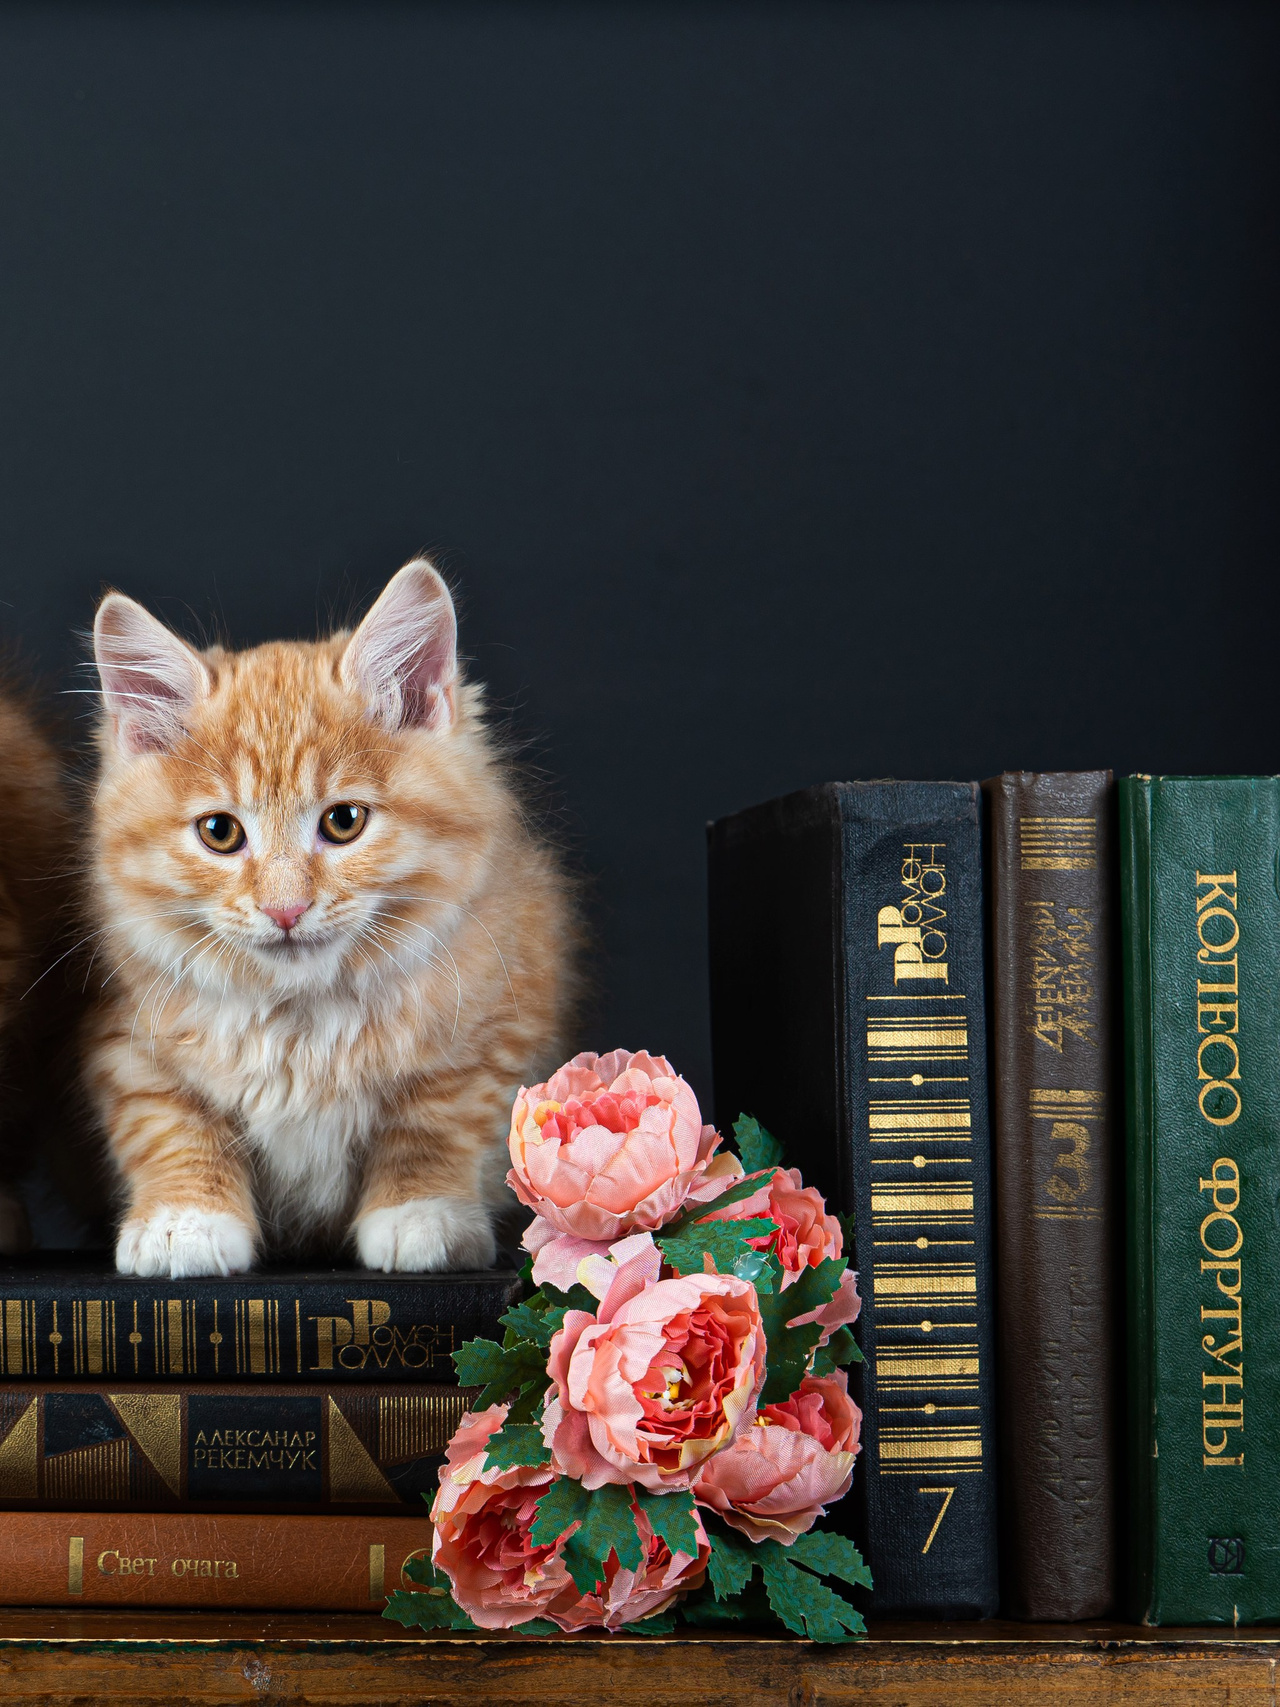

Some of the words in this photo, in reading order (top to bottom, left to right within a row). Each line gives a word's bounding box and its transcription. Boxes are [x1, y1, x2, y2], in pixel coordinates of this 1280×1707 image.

[1196, 869, 1242, 1127] КОЛЕСО
[1199, 1157, 1245, 1472] ФОРТУНЫ
[193, 1449, 317, 1470] РЕКЕМЧУК
[194, 1429, 316, 1448] АЛЕКСАНДР
[918, 1486, 958, 1555] 7
[96, 1549, 158, 1577] Свет
[171, 1556, 240, 1579] очага
